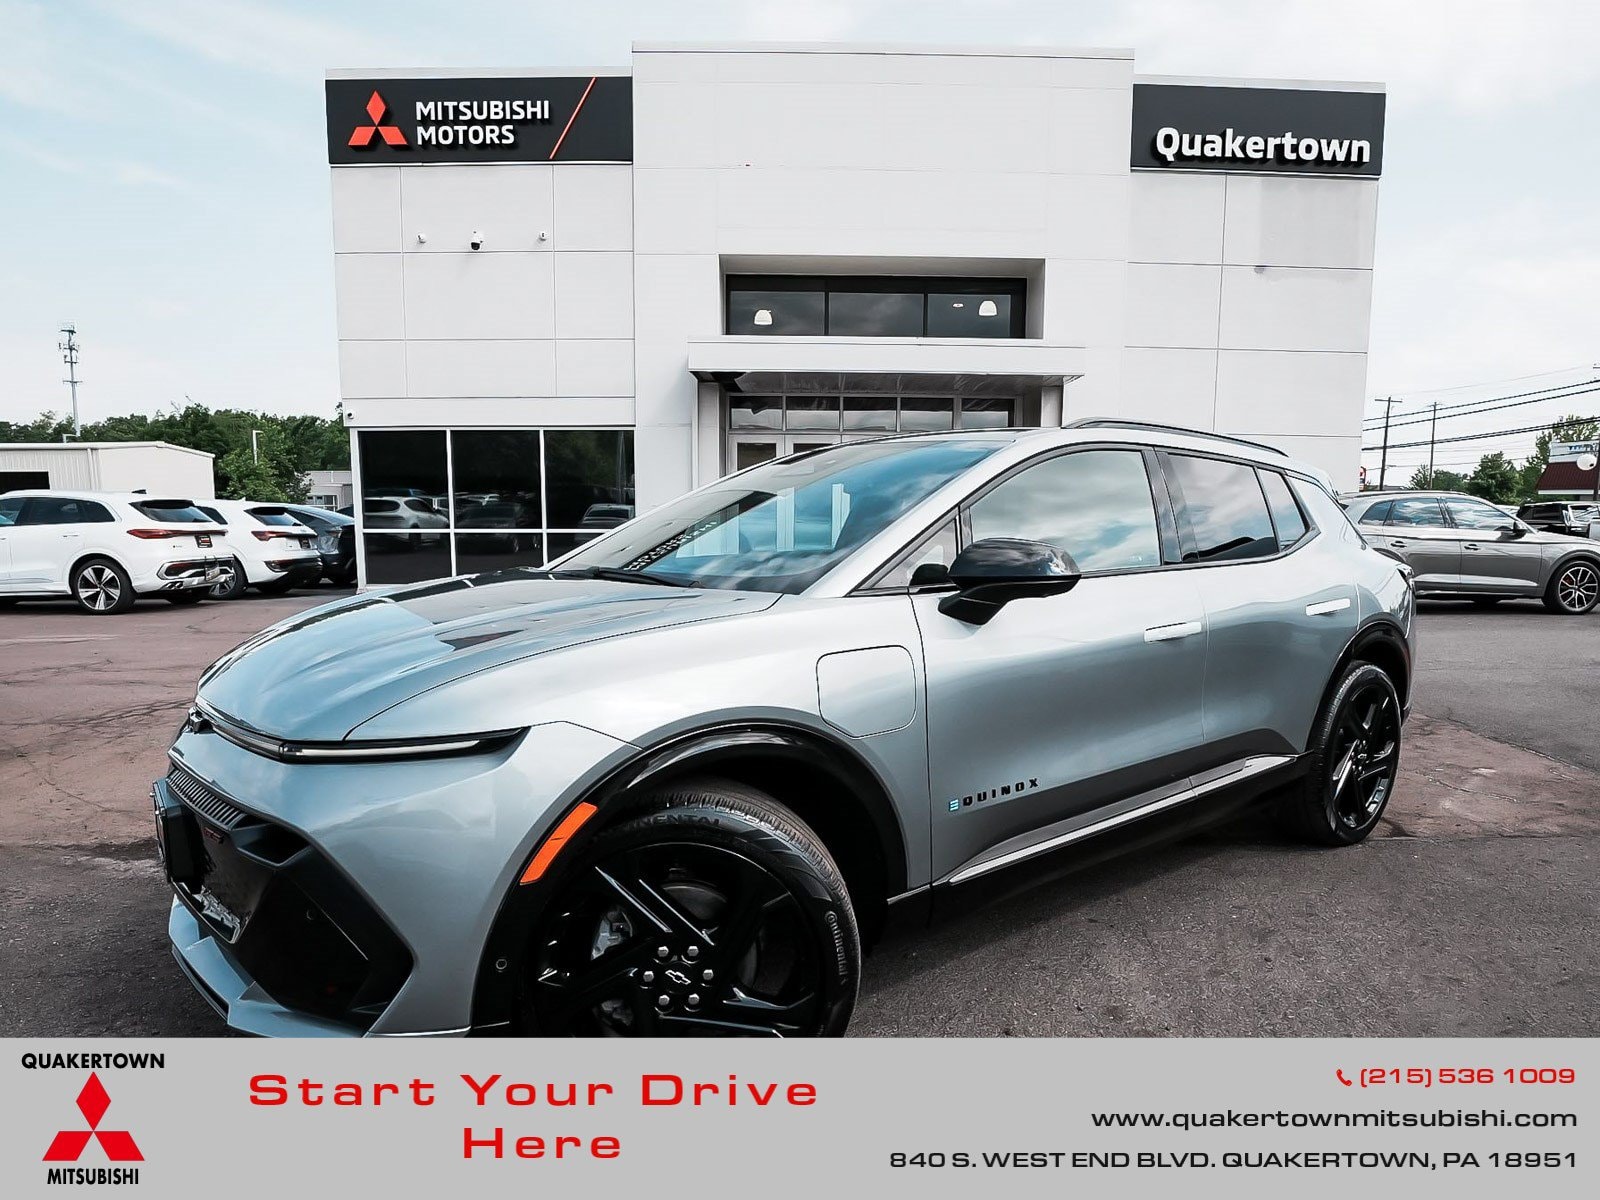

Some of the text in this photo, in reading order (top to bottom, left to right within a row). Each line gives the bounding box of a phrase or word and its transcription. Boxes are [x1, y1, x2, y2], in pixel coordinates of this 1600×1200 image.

[415, 99, 550, 121] MITSUBISHI
[416, 123, 516, 146] MOTORS
[1155, 126, 1371, 164] Quakertown
[948, 777, 1040, 812] EQUINOX
[824, 910, 848, 977] Continental
